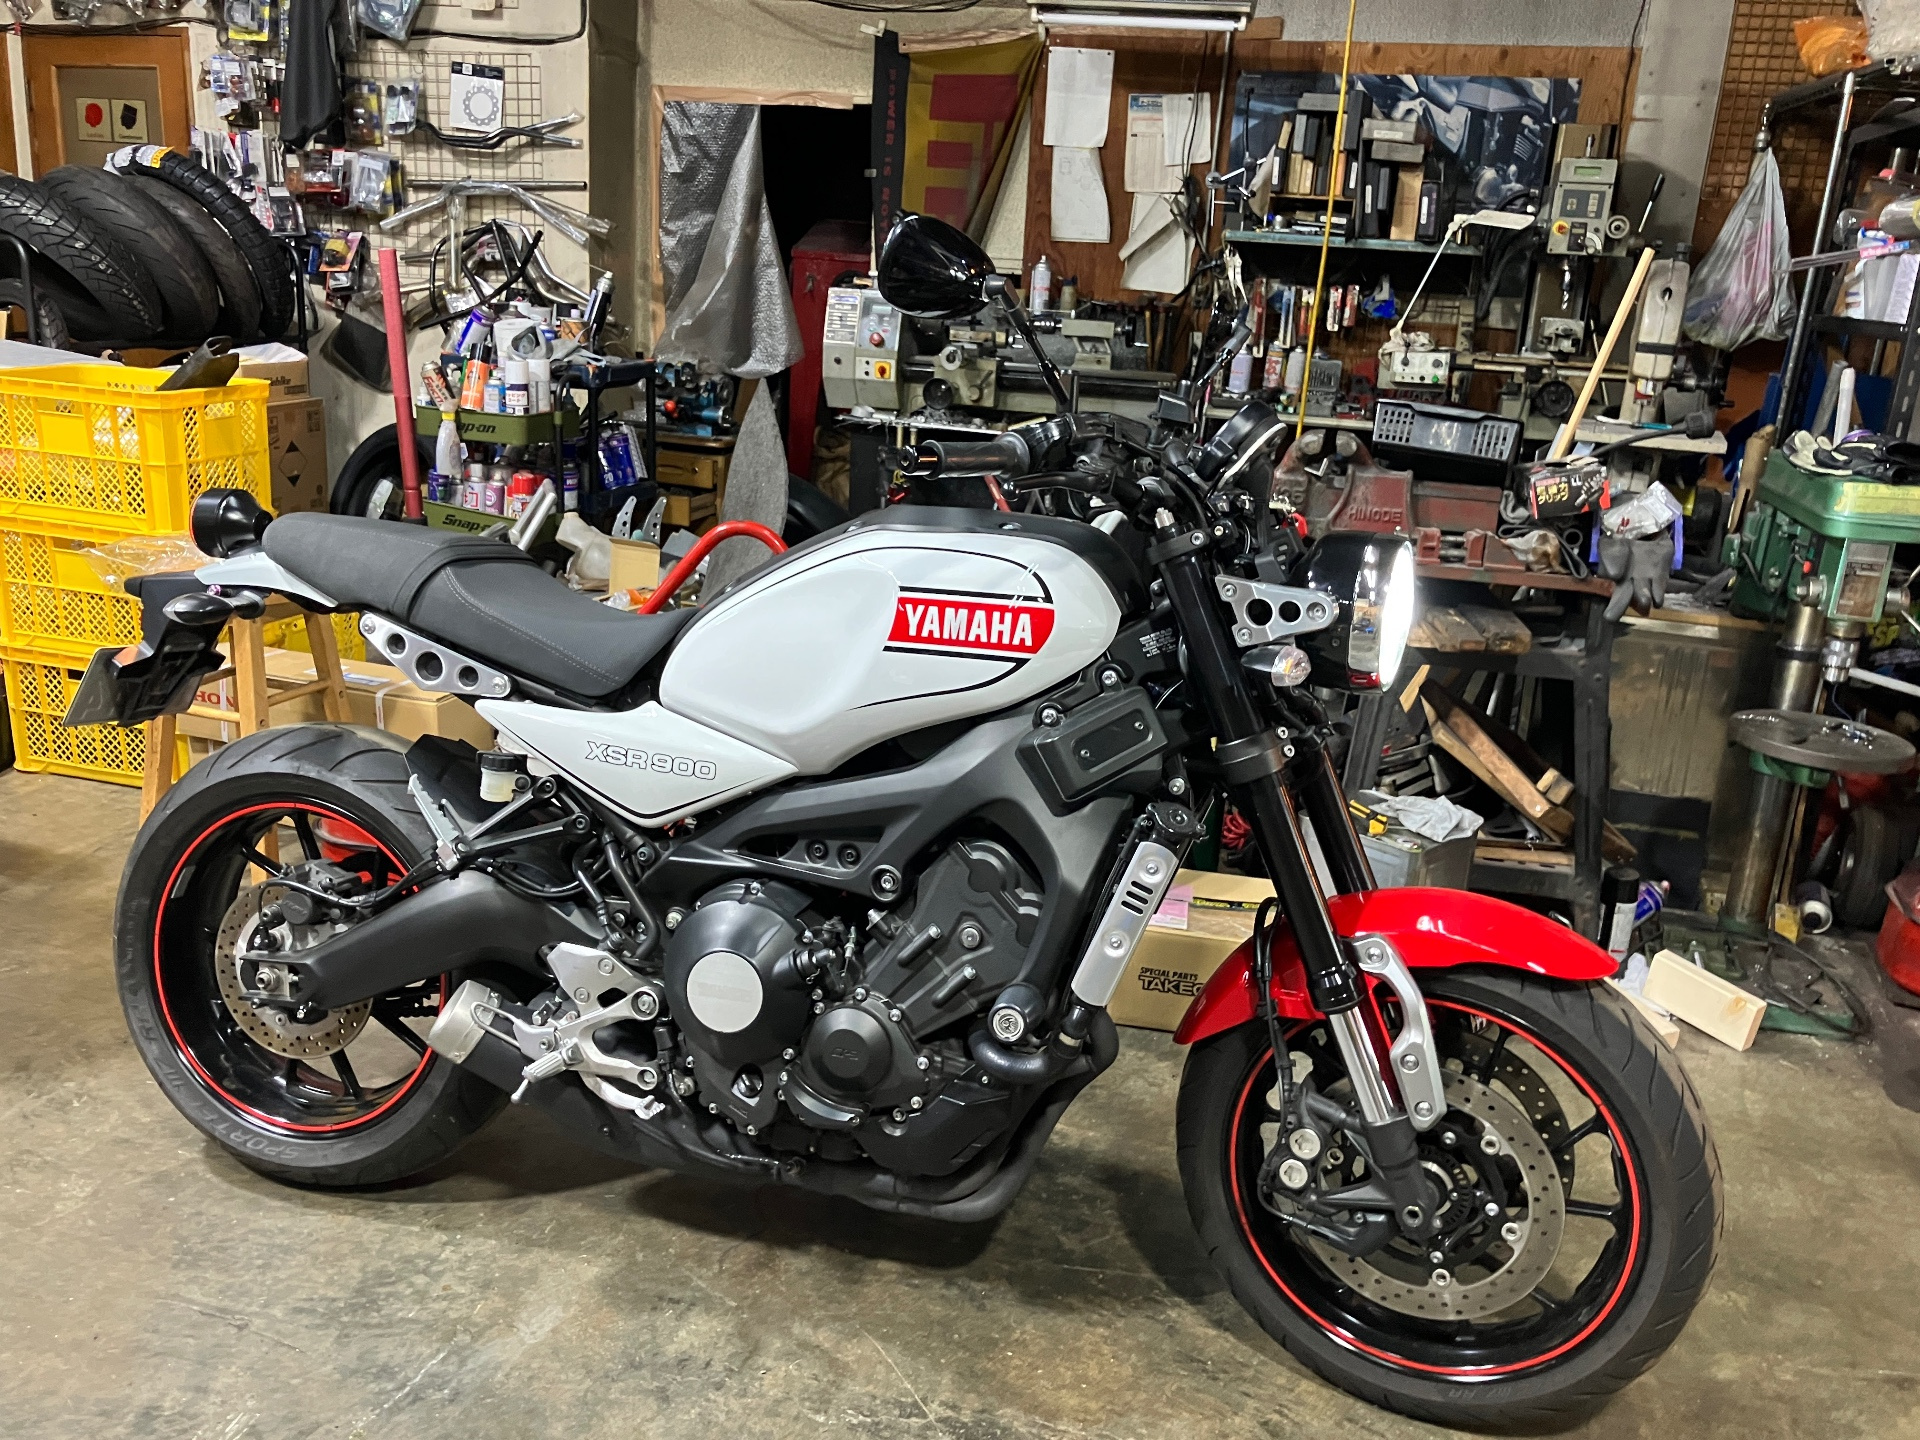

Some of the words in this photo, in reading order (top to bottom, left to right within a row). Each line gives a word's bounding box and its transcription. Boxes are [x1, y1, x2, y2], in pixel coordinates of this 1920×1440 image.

[1348, 505, 1403, 522] HINODE
[905, 603, 1033, 647] YAMAHA
[585, 740, 649, 770] XSR
[650, 753, 717, 781] 900
[1140, 967, 1171, 978] SPECIAL
[1172, 971, 1199, 981] PARTS
